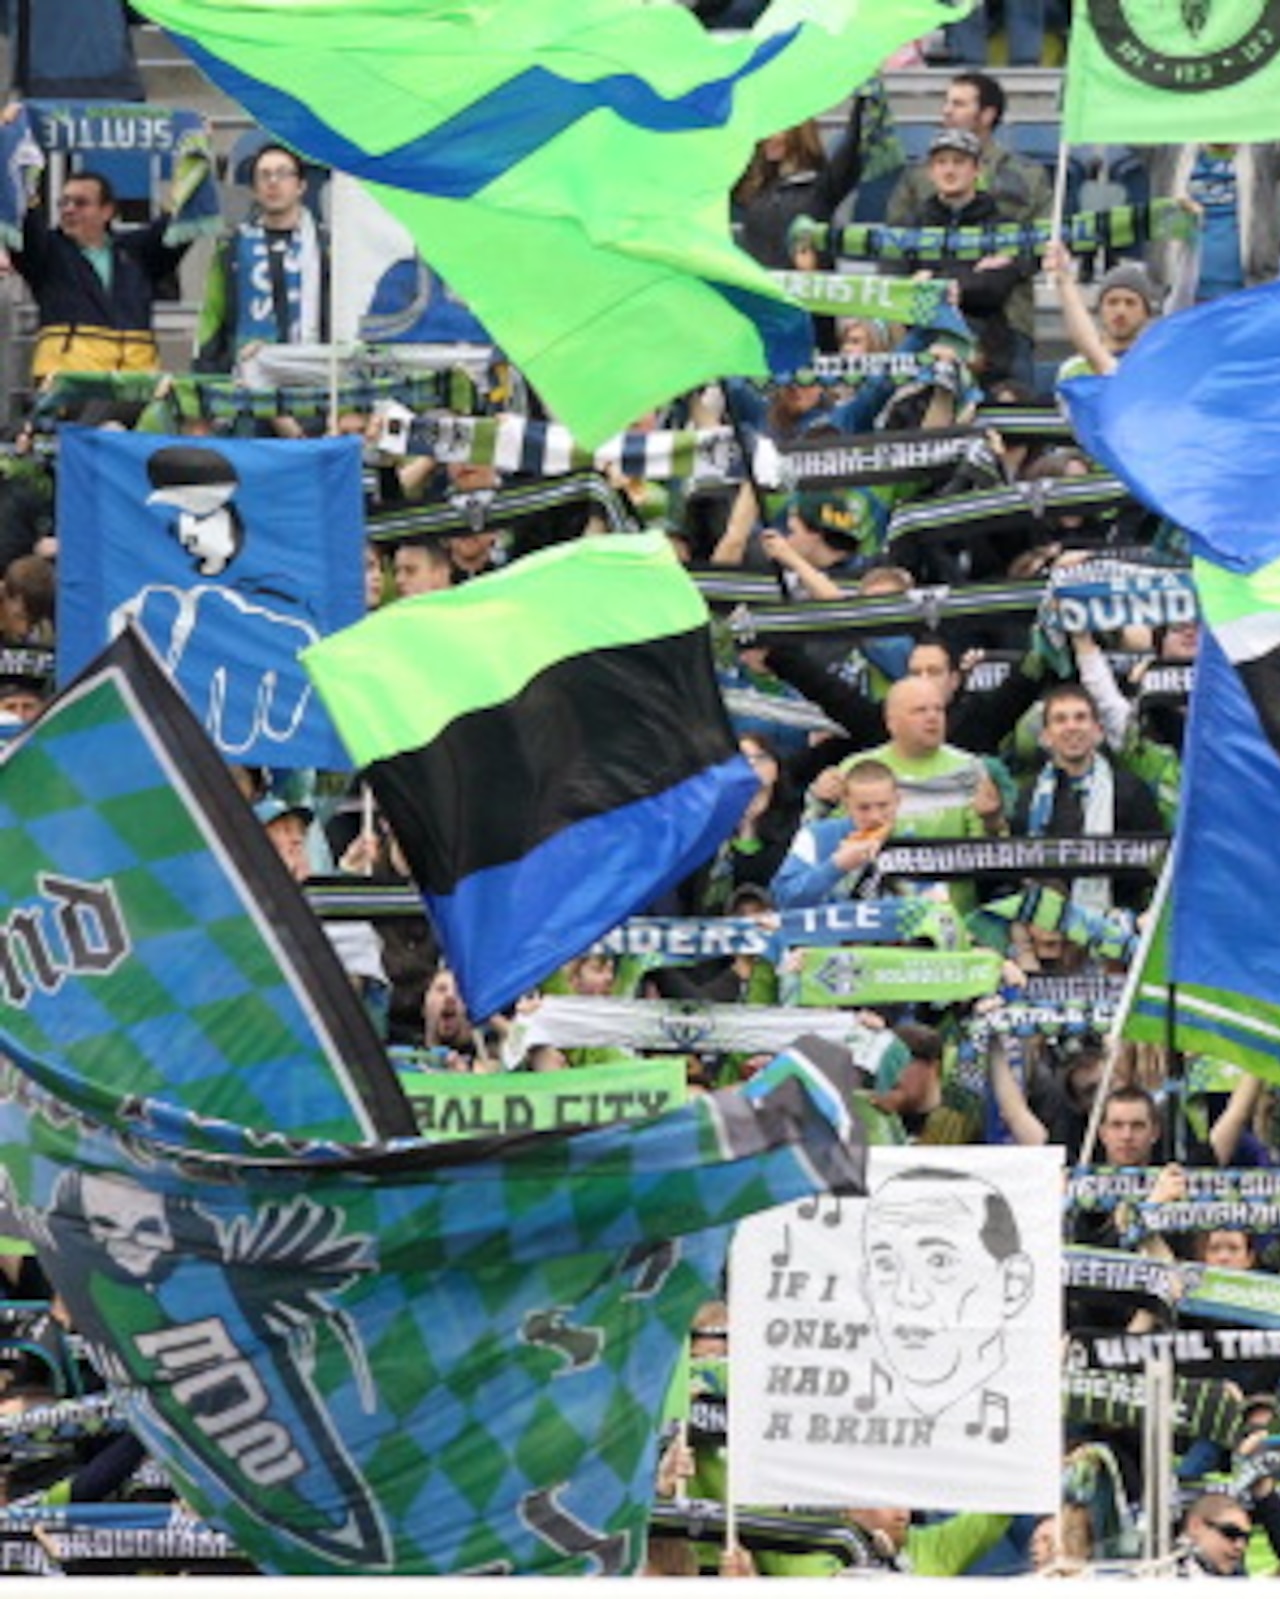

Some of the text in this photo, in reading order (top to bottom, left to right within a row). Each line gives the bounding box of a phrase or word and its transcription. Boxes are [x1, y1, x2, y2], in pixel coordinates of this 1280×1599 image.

[554, 1090, 670, 1128] CITY
[766, 1270, 837, 1302] IF I
[765, 1318, 871, 1350] ONLY
[1093, 1332, 1213, 1367] UNTIL
[766, 1365, 851, 1397] HAD
[763, 1412, 792, 1441] A
[805, 1412, 936, 1448] BRAIN
